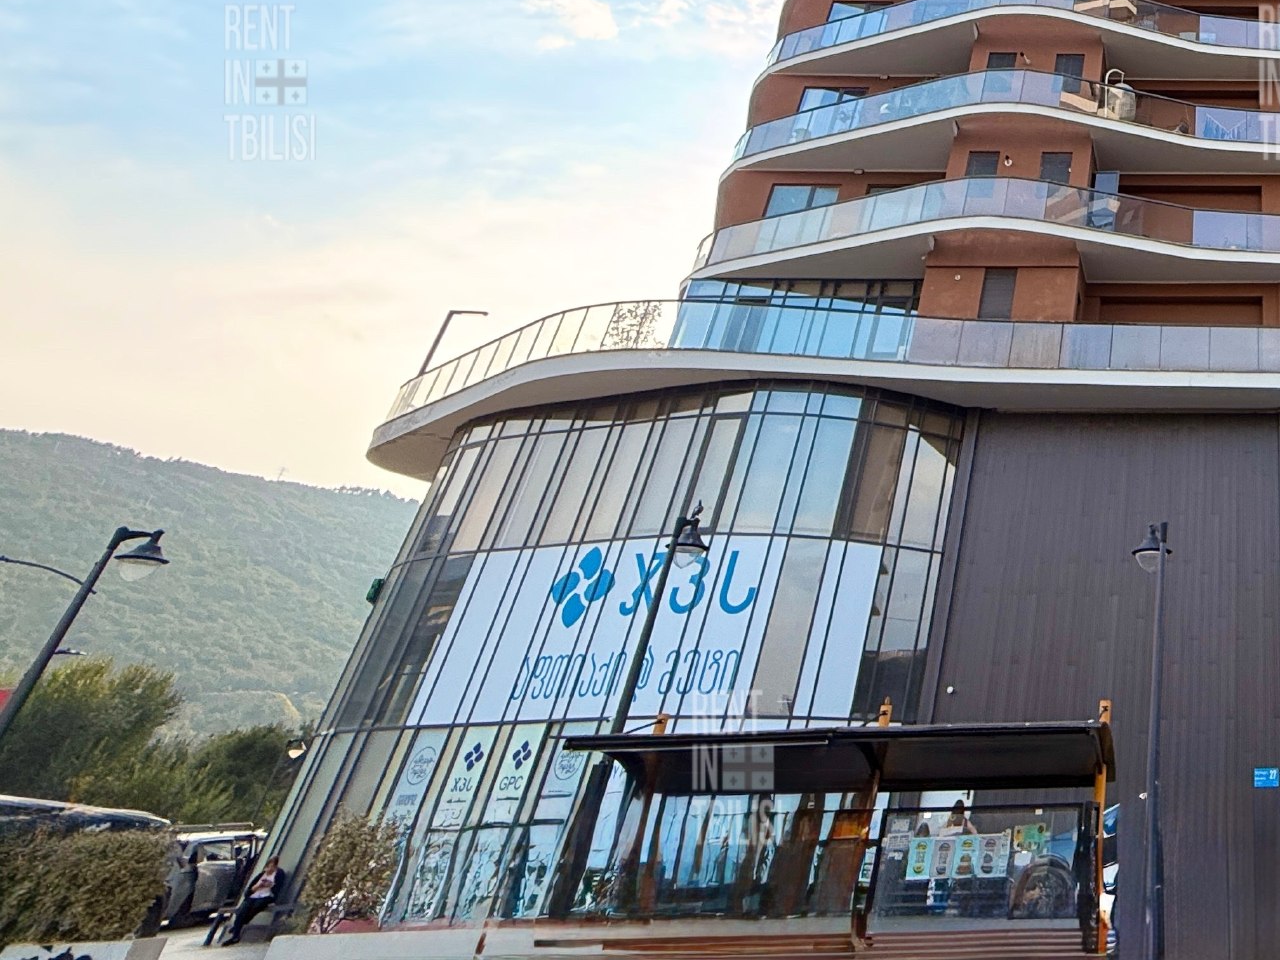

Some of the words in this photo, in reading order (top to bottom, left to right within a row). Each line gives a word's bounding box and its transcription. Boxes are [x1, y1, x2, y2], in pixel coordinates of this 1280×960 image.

[511, 651, 627, 700] აფთიაქი
[658, 648, 740, 696] მეტი
[498, 775, 524, 792] GPC
